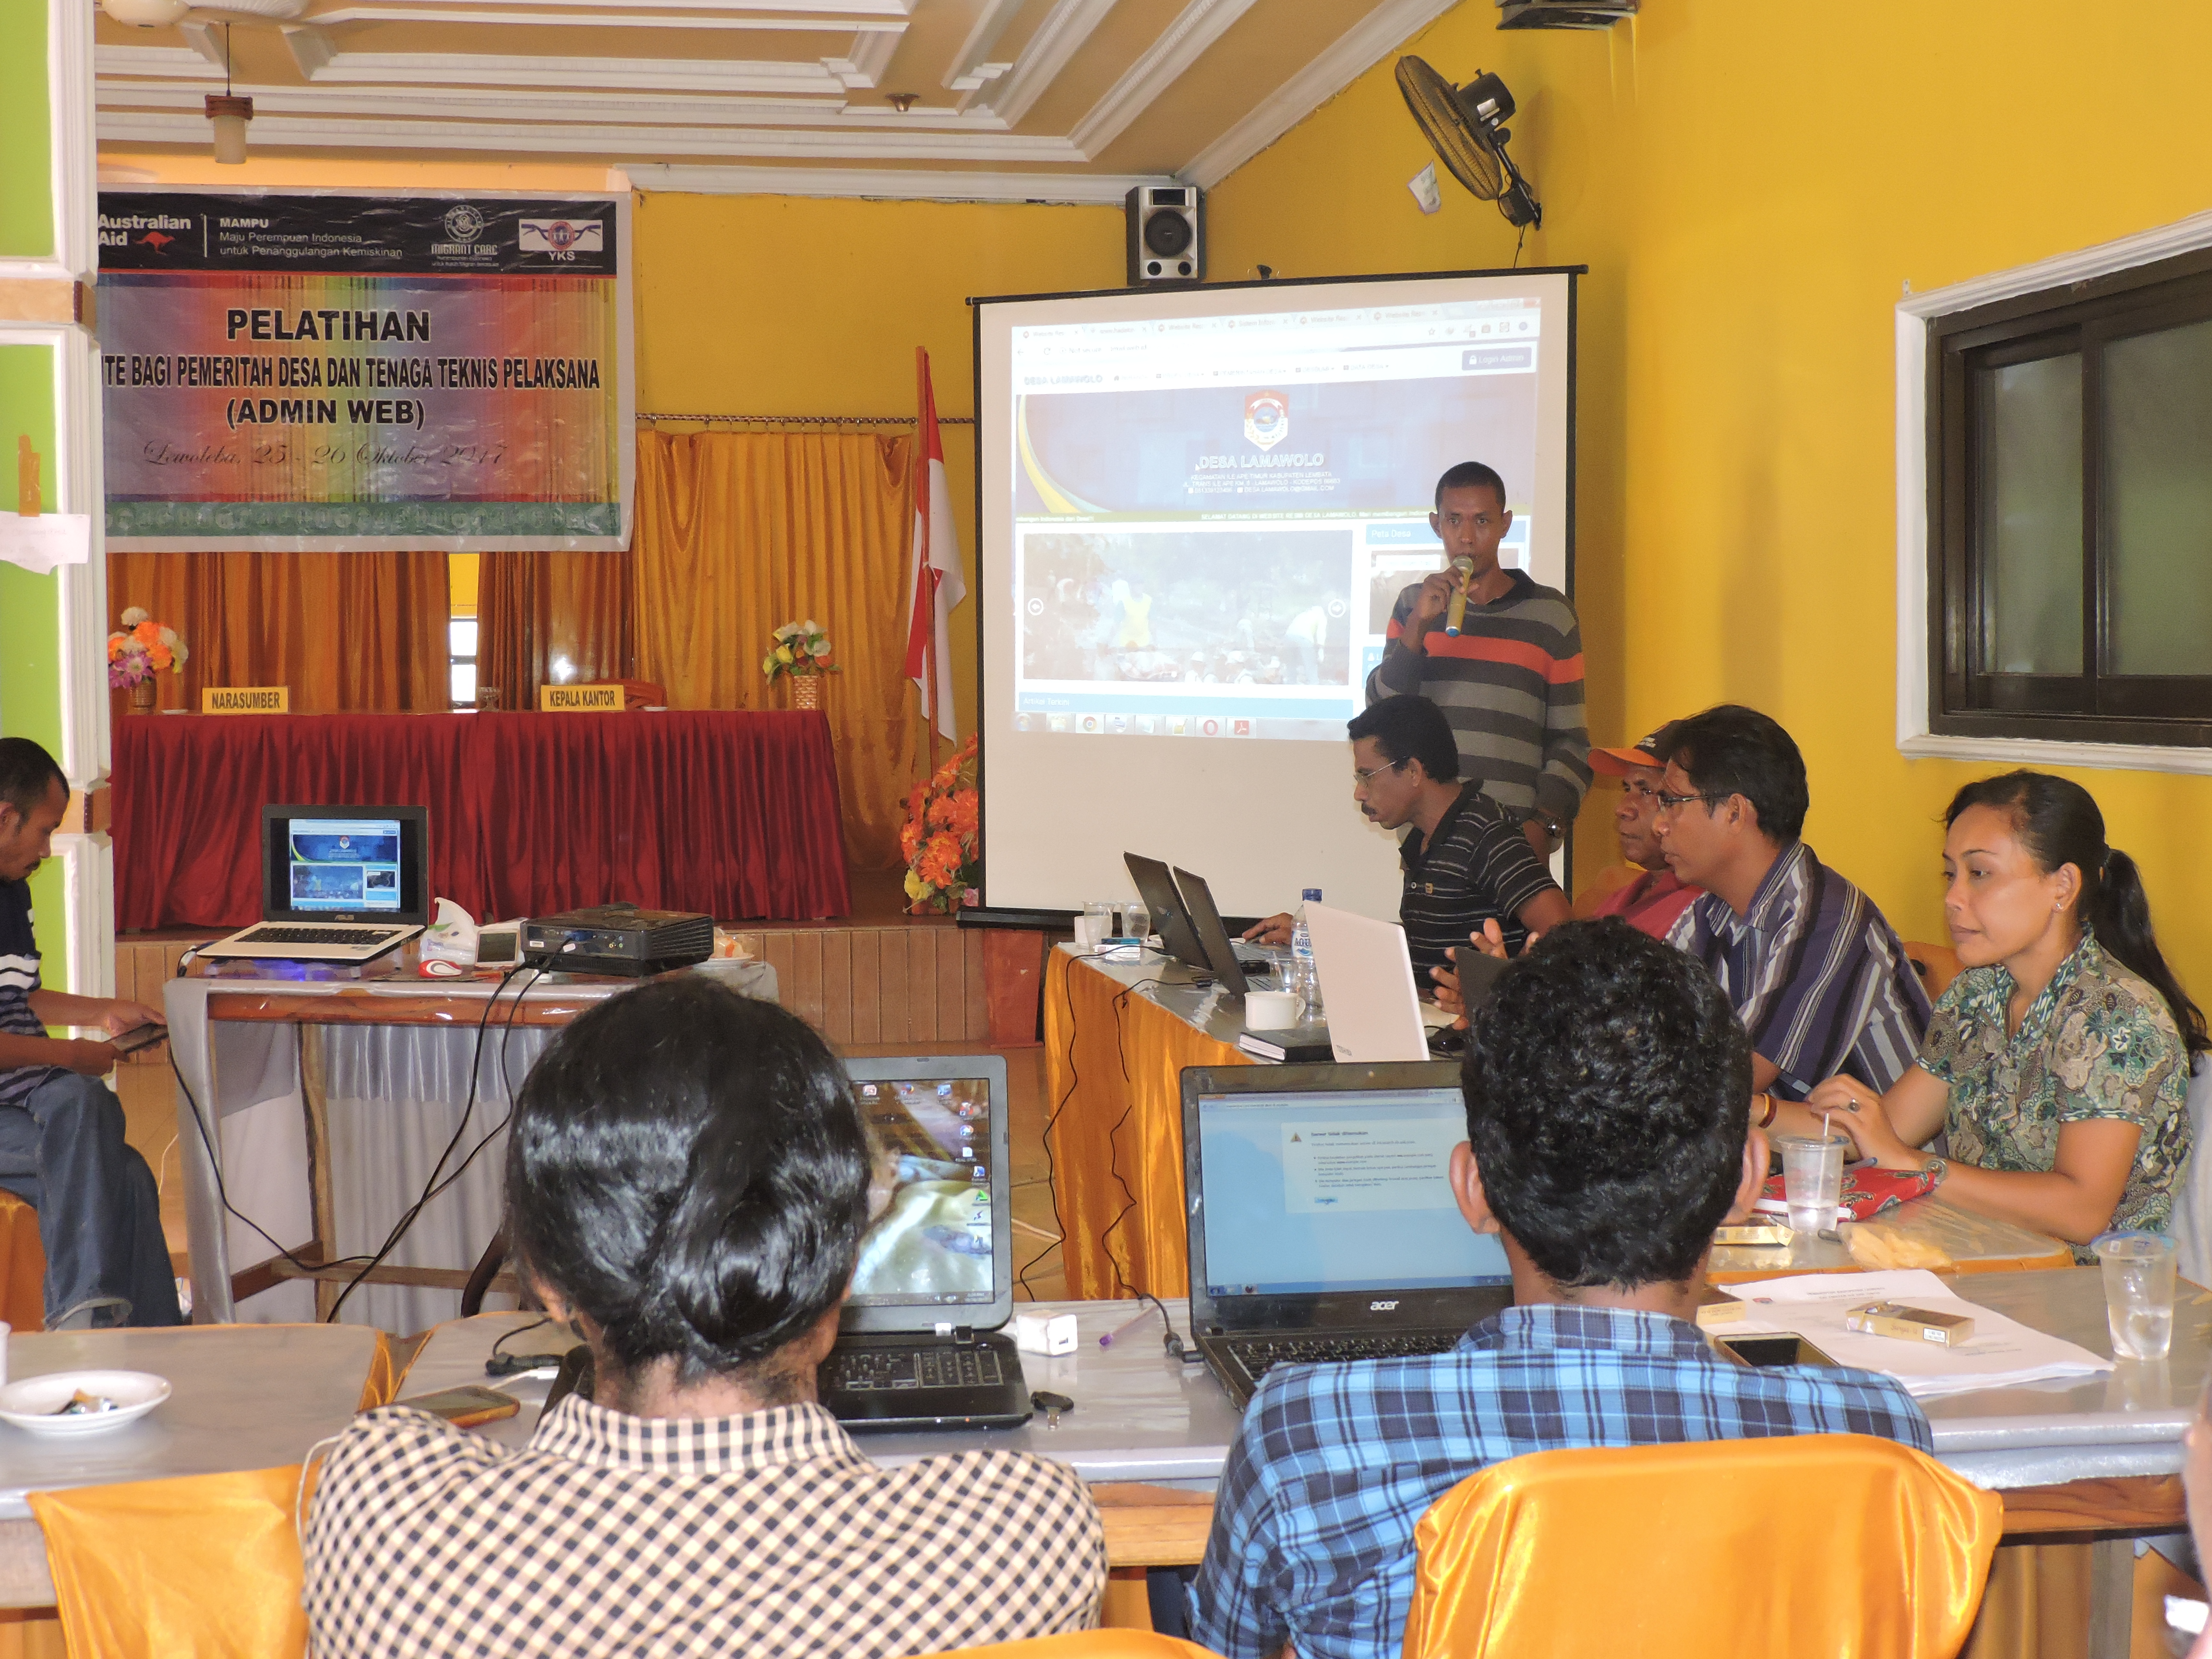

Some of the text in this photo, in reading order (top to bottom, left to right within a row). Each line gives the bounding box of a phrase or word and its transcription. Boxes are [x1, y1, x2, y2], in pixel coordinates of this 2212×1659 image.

[98, 214, 192, 230] Australian
[220, 218, 269, 228] MAMPU
[98, 231, 128, 246] Aid
[220, 232, 362, 245] Maju Perempuan Indonesia
[220, 246, 403, 258] untuk Penanggulangan Kemiskinan
[548, 251, 575, 261] YKS
[227, 310, 430, 342] PELATIHAN
[1479, 356, 1499, 365] Login
[132, 356, 171, 386] BAGI
[178, 356, 273, 387] PEMERITAH
[279, 357, 322, 387] DESA
[327, 357, 361, 387] DAN
[366, 358, 433, 388] TENAGA
[437, 358, 498, 388] TEKNIS
[504, 358, 600, 389] PELAKSANA
[227, 398, 424, 431] (ADMIN WEB)
[253, 445, 288, 464] 25
[311, 445, 346, 464] 26
[440, 442, 507, 465] 2017
[1200, 453, 1324, 469] DESA LAMAWOLO
[1371, 529, 1412, 538] Peta Desa
[212, 691, 280, 709] NARASUMBER
[549, 690, 616, 707] KEPALA KANTOR
[1023, 697, 1070, 707] Artikel Terkini
[1370, 1300, 1399, 1311] acer
